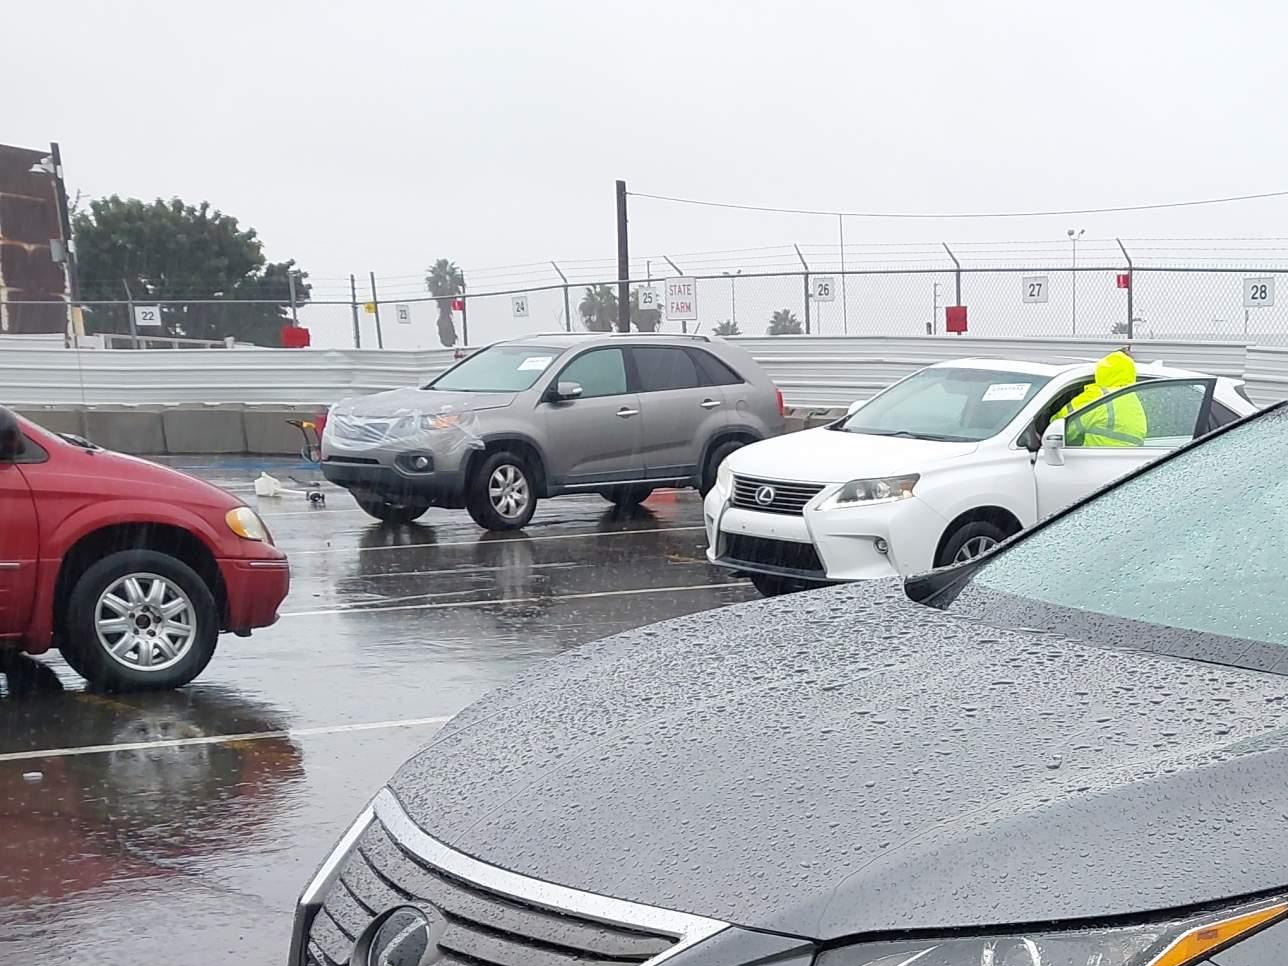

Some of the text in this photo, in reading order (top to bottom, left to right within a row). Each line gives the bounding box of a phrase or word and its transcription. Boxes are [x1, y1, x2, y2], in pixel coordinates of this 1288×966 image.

[669, 284, 692, 296] STATE
[818, 284, 829, 296] 26
[1028, 283, 1042, 297] 27
[1251, 285, 1267, 300] 28
[642, 292, 653, 304] 25
[516, 302, 525, 313] 24
[671, 302, 692, 313] FARM
[141, 311, 155, 322] 22
